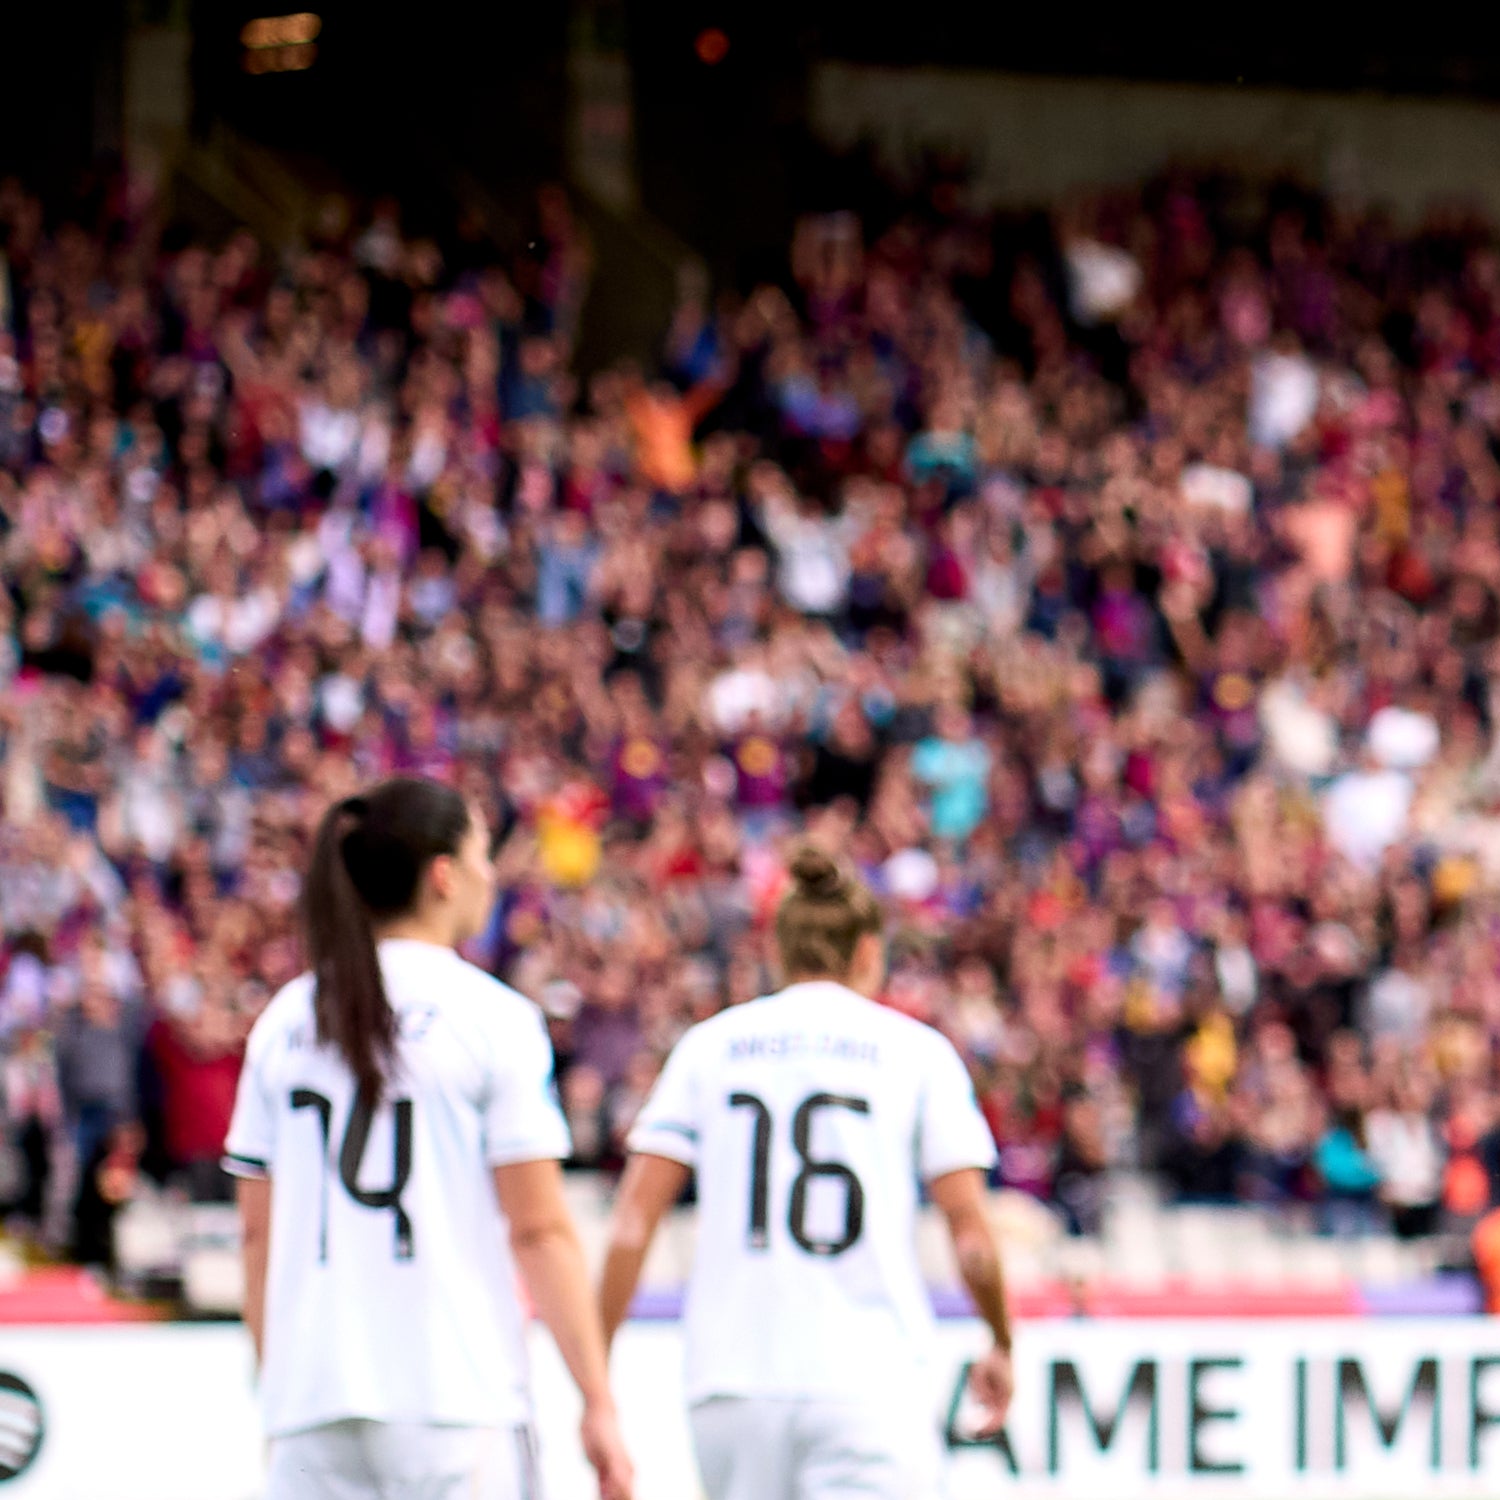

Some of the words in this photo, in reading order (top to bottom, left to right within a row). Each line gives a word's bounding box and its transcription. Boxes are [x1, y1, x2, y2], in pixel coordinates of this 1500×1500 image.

[288, 1086, 415, 1266] 14
[728, 1091, 871, 1257] 16
[945, 1357, 1247, 1476] AME
